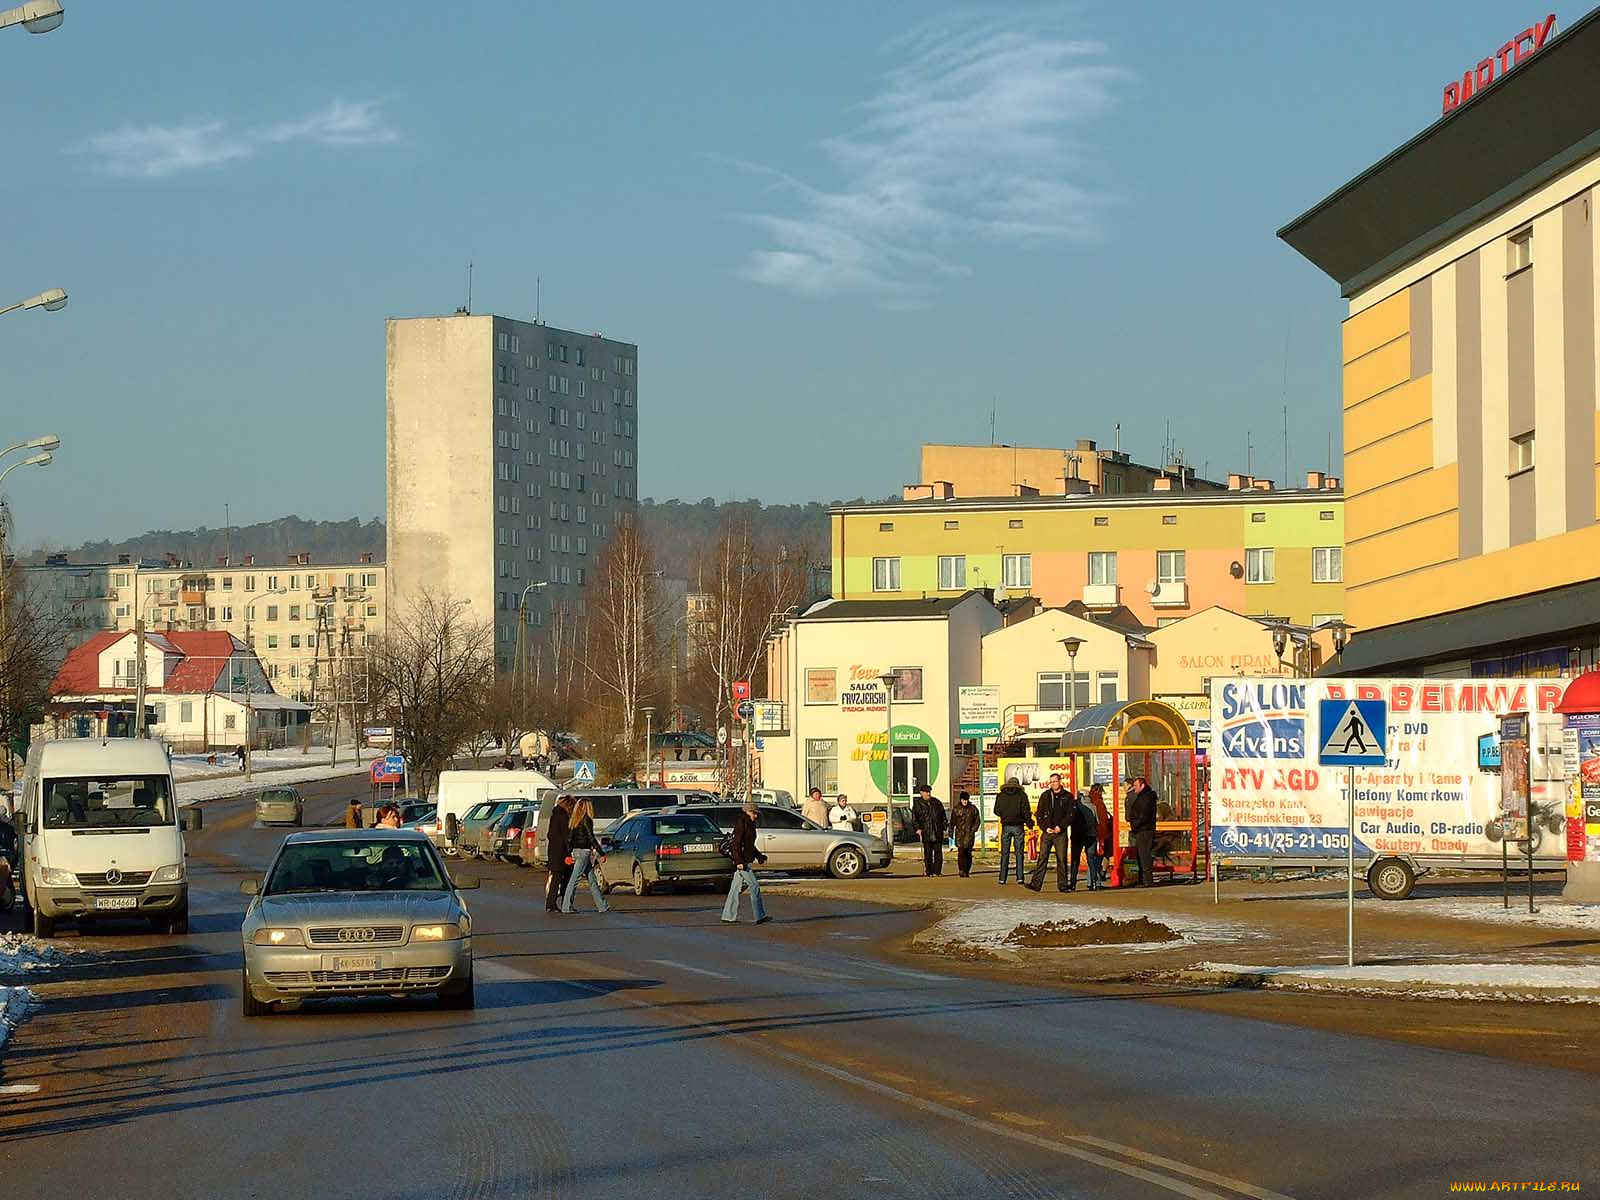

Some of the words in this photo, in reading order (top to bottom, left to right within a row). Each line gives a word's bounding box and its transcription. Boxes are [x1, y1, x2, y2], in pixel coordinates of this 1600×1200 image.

[850, 682, 878, 691] SALON
[841, 692, 887, 705] FRYZJERSKI
[1221, 683, 1306, 720] SALON
[1404, 723, 1428, 735] DVD
[855, 731, 889, 745] okna
[1228, 726, 1301, 753] Avans
[1221, 768, 1264, 791] RTV
[1272, 768, 1319, 791] AGD
[1340, 789, 1393, 804] Tlefony
[1309, 814, 1323, 825] 23
[1360, 822, 1381, 834] Car
[1386, 822, 1425, 837] Audio,
[1431, 822, 1484, 835] CB-radio
[1238, 832, 1350, 849] 0-41/25-21-050
[1374, 838, 1426, 853] Skutery,
[1431, 838, 1470, 853] Quady
